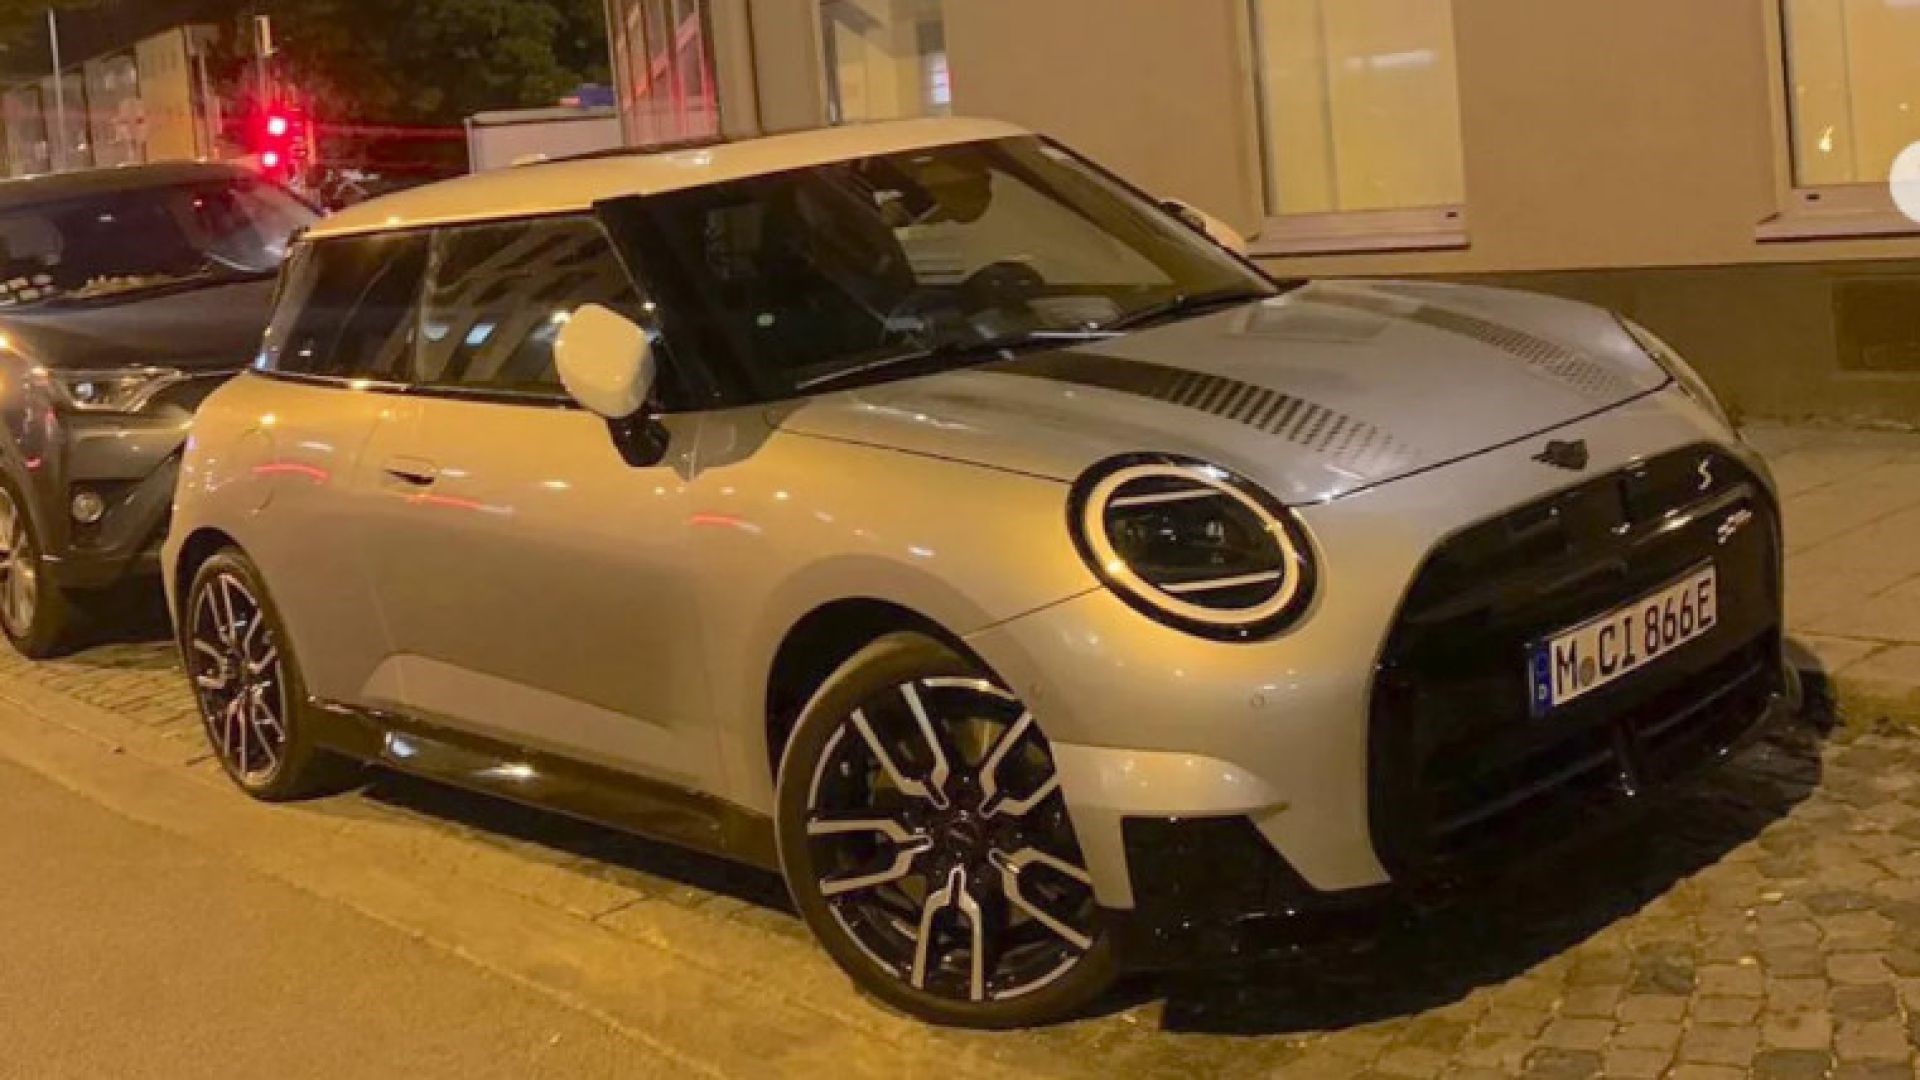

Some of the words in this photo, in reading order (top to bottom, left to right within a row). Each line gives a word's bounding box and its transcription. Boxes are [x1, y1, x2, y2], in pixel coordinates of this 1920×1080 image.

[1697, 458, 1712, 490] S
[1556, 640, 1577, 695] M
[1600, 616, 1636, 675] CI
[1644, 577, 1712, 655] 866E
